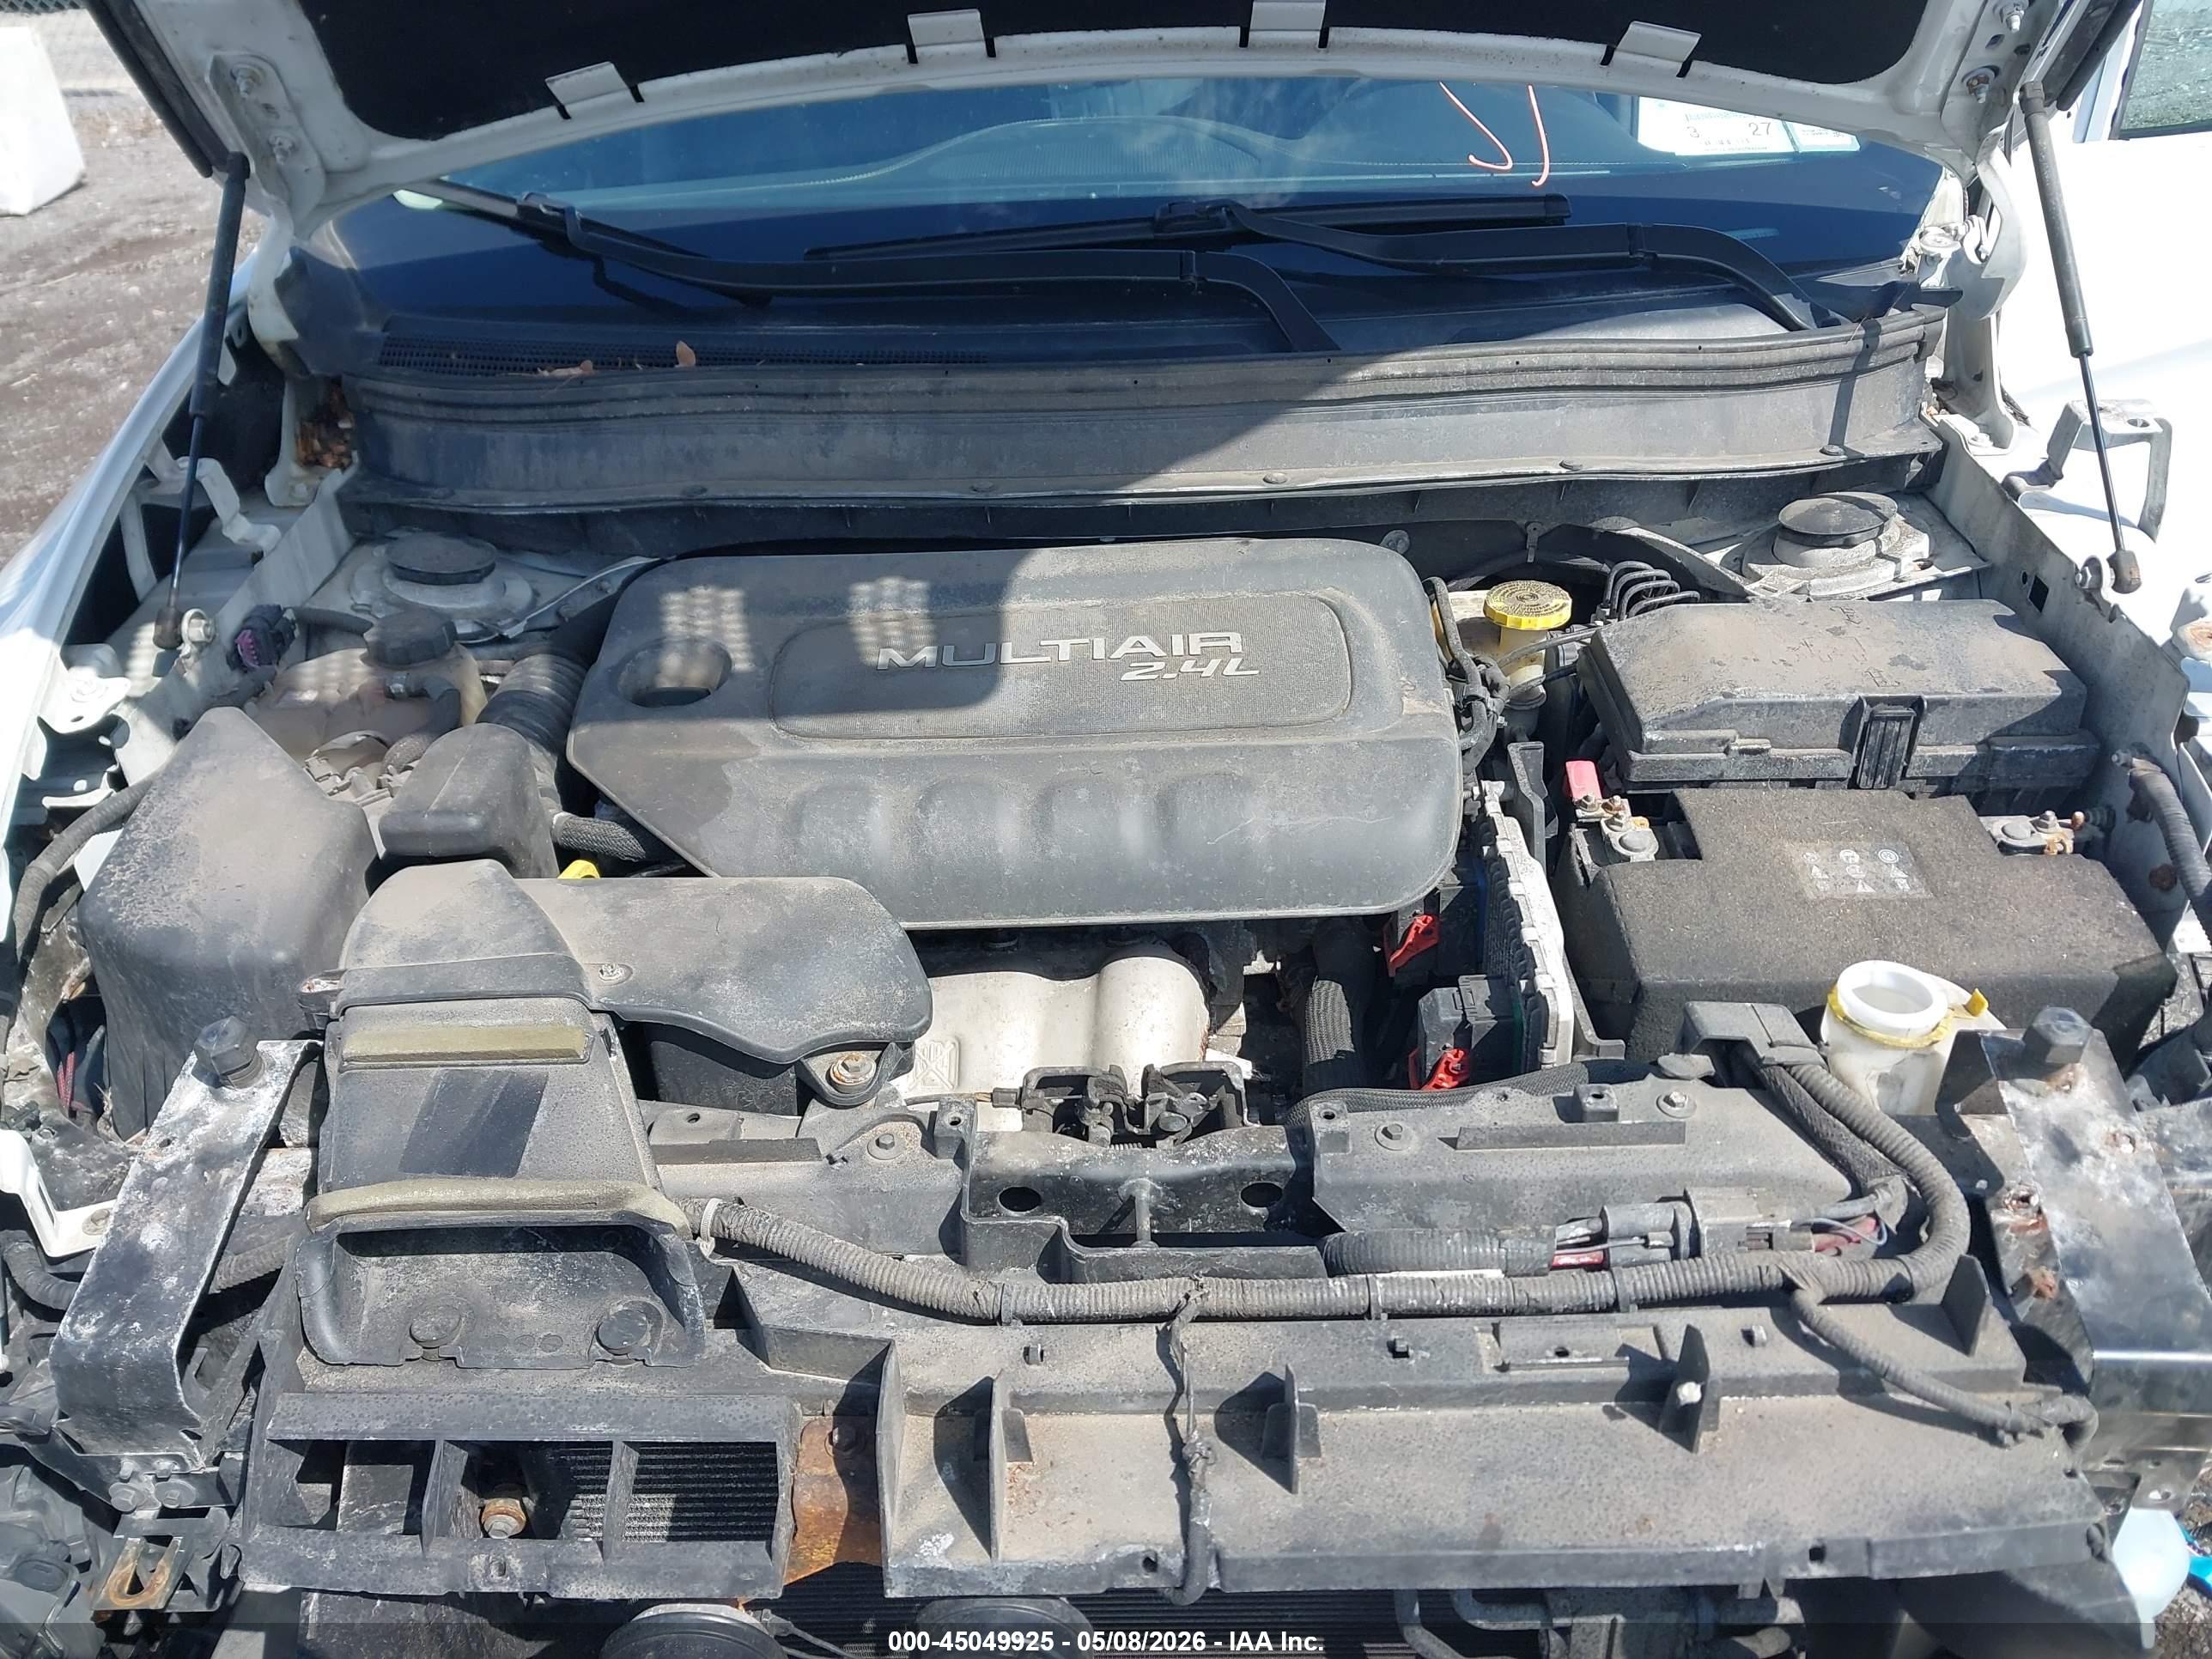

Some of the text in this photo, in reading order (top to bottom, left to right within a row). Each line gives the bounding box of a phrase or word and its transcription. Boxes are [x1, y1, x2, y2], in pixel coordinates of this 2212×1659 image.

[1748, 121, 1771, 137] 27
[876, 631, 1243, 671] MULTIAIR
[1120, 657, 1261, 681] 2.4L
